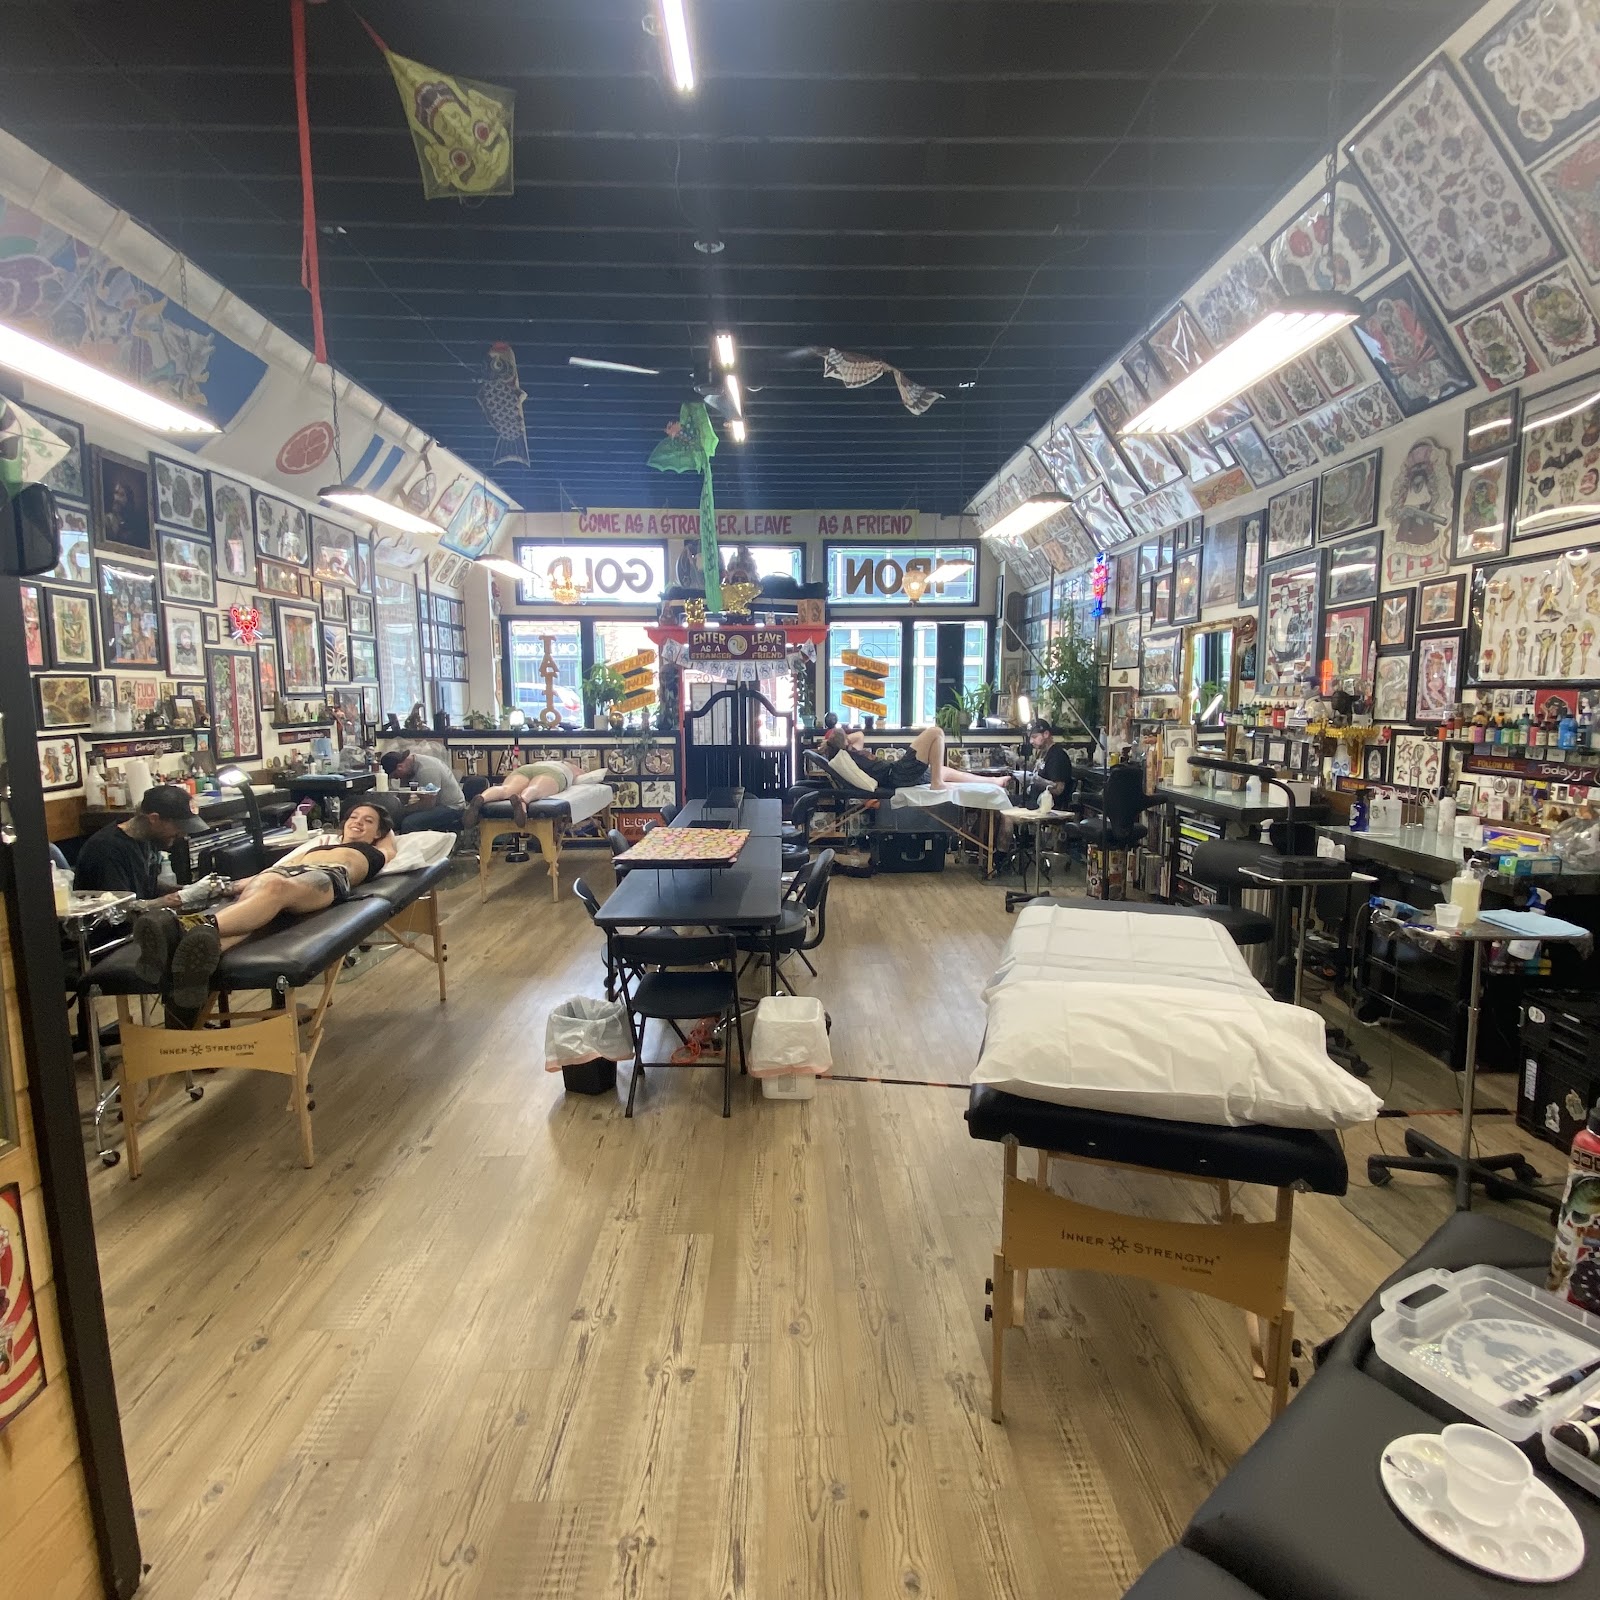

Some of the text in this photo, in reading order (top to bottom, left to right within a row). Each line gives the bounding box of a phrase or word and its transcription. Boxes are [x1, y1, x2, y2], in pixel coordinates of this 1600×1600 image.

[579, 513, 913, 535] COME AS A STRANER, LEAVE AS A FRIEND
[693, 632, 726, 645] ENTER
[751, 632, 782, 645] LEAVE
[137, 683, 155, 697] FUCK
[1478, 760, 1515, 770] FOLLOW ME
[1061, 1229, 1104, 1246] INNER
